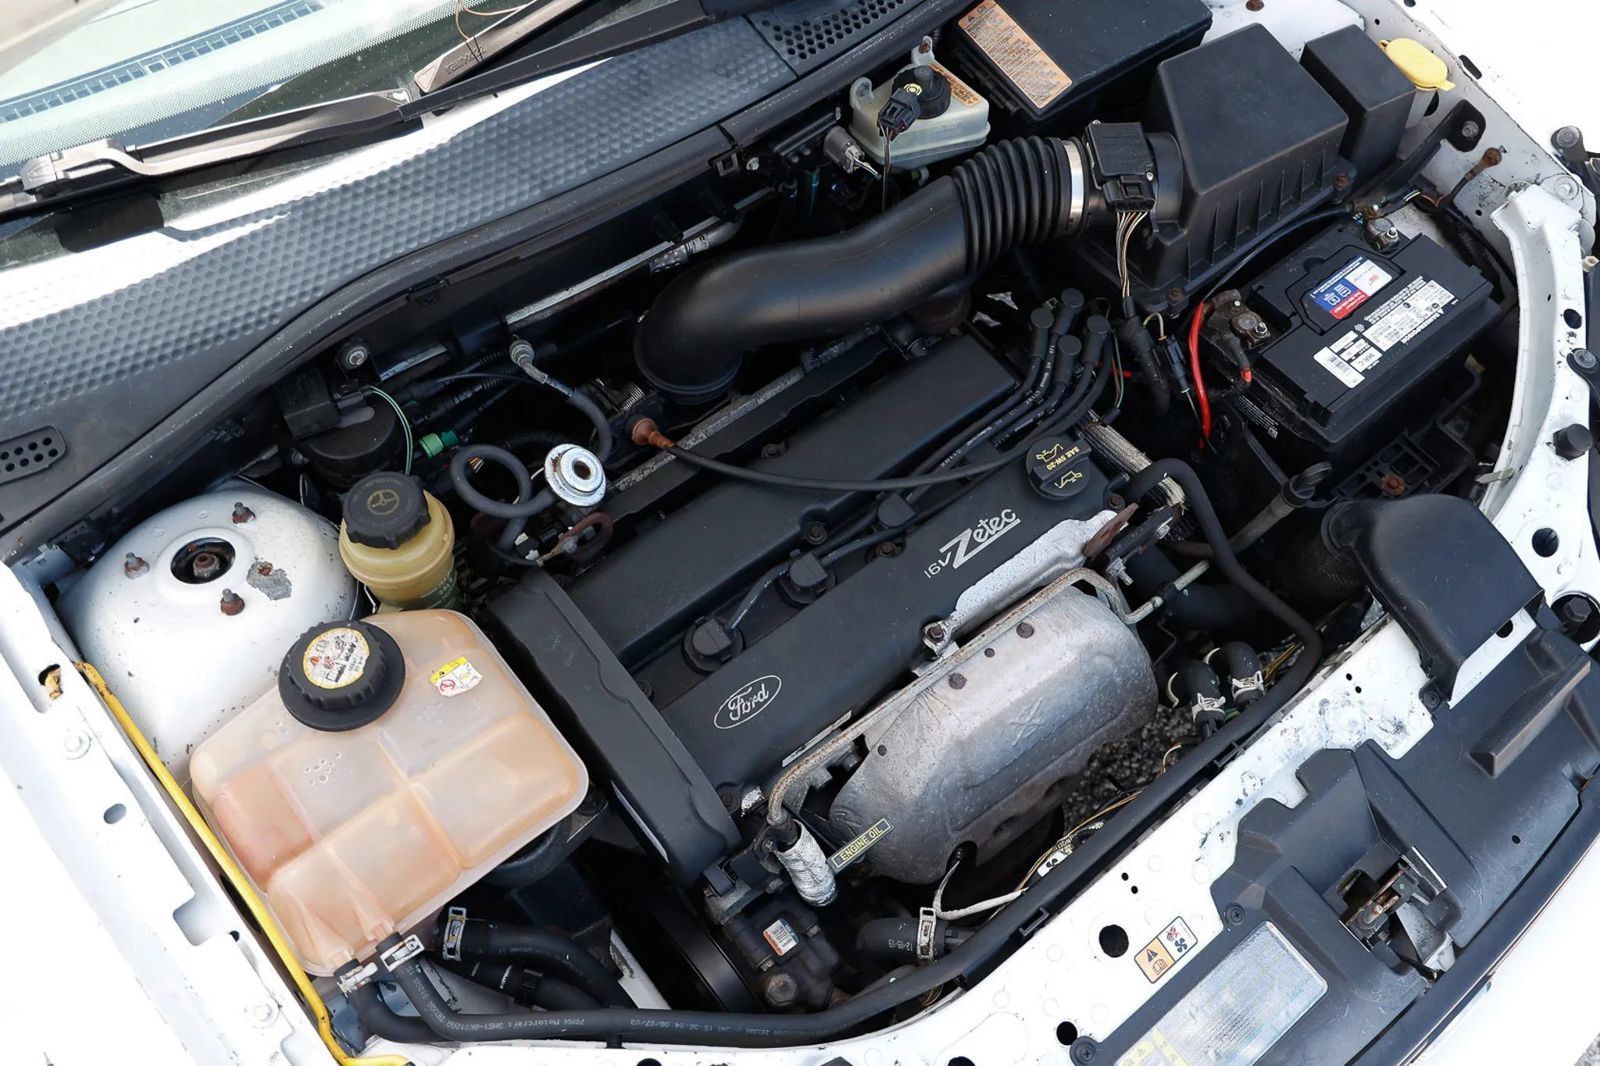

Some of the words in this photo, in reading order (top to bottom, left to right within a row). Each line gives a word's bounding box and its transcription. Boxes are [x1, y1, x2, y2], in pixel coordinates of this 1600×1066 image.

[1046, 454, 1067, 471] 5W-20
[1065, 446, 1080, 459] SAE
[938, 508, 1021, 570] Zetec
[727, 682, 770, 721] Ford
[839, 835, 870, 861] ENGINE
[868, 825, 884, 839] OIL
[508, 1018, 561, 1029] Motorcraft
